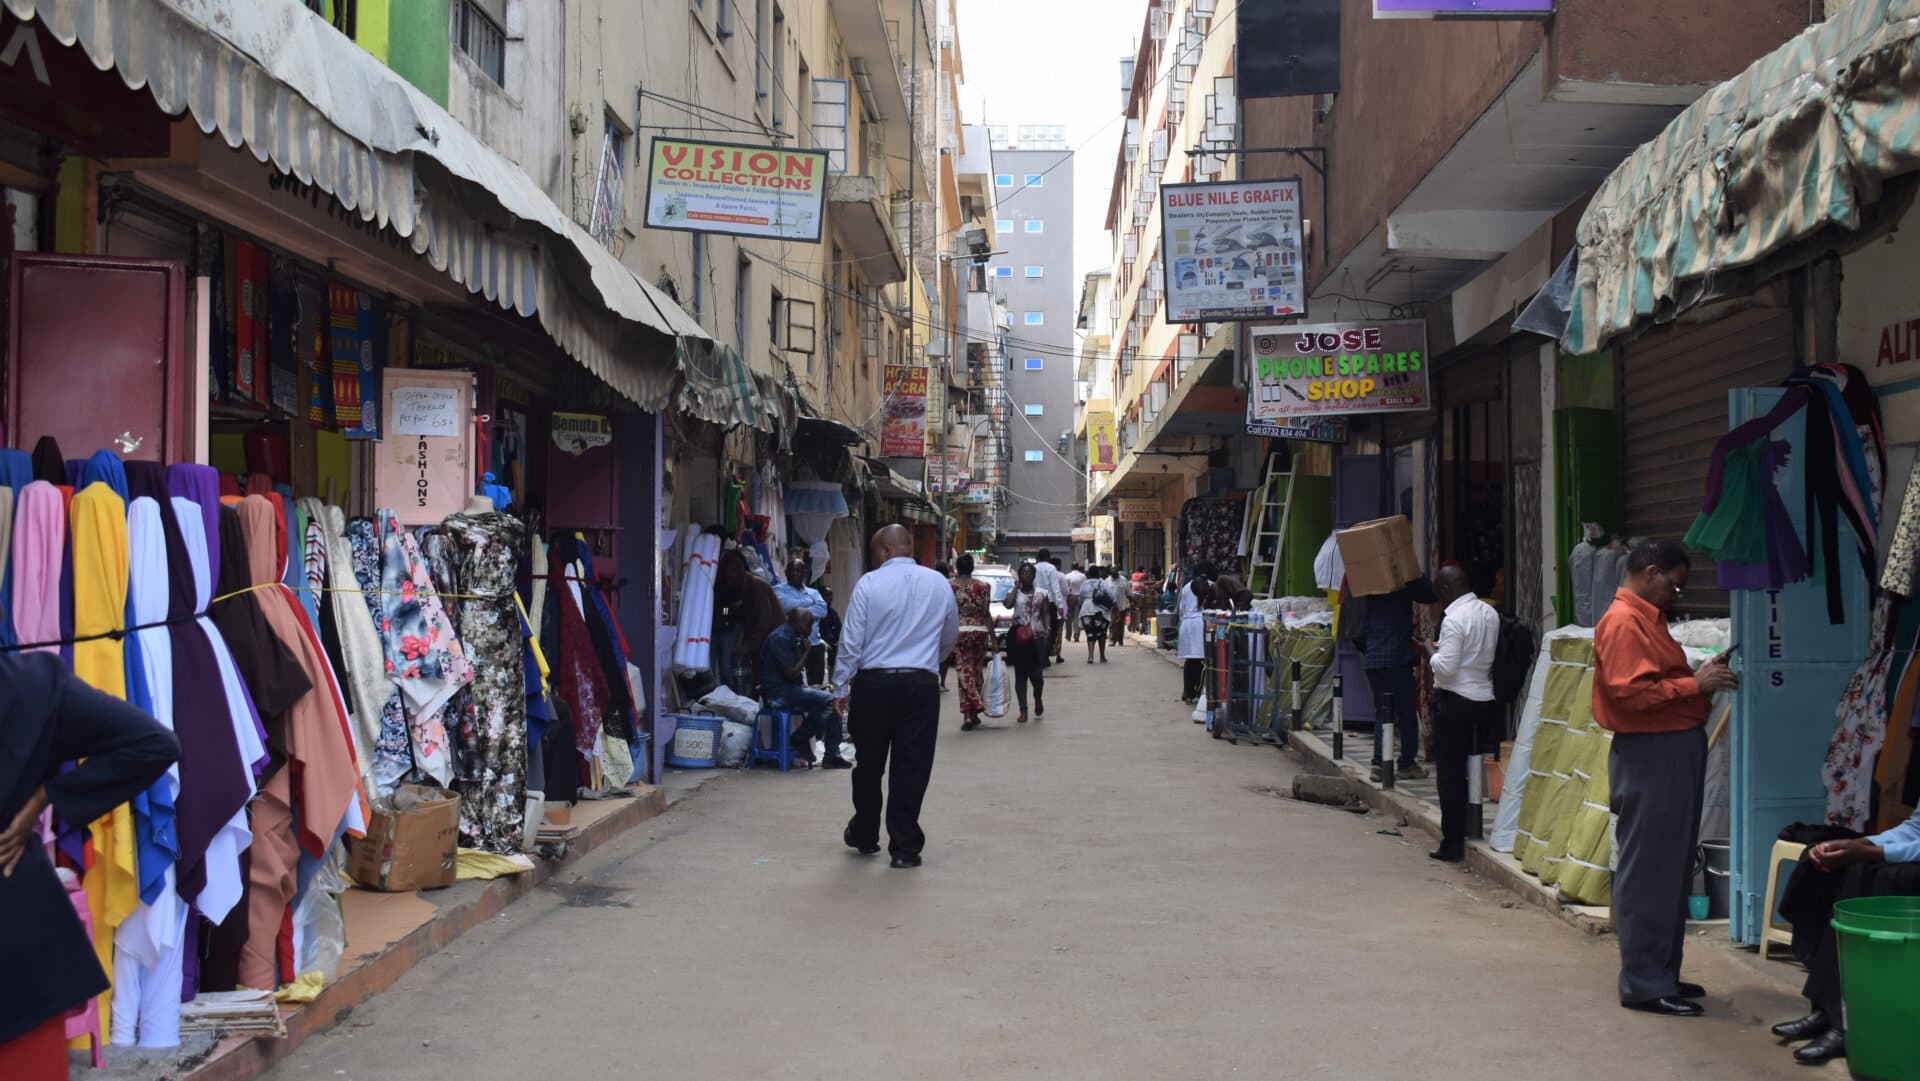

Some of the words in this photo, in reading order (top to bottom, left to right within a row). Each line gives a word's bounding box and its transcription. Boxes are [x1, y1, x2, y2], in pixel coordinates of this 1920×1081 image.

[662, 145, 813, 178] VISION
[662, 167, 812, 191] COLLECTIONS
[1168, 193, 1204, 207] BLUE
[1208, 191, 1239, 205] NILE
[1243, 188, 1293, 203] GRAFIX
[1168, 210, 1194, 219] Dealers
[1296, 328, 1382, 353] JOSE
[885, 367, 926, 380] HOEL
[1257, 354, 1335, 381] PHONE
[1337, 352, 1422, 377] SPARES
[1307, 377, 1376, 401] SHOP
[1260, 405, 1276, 414] For
